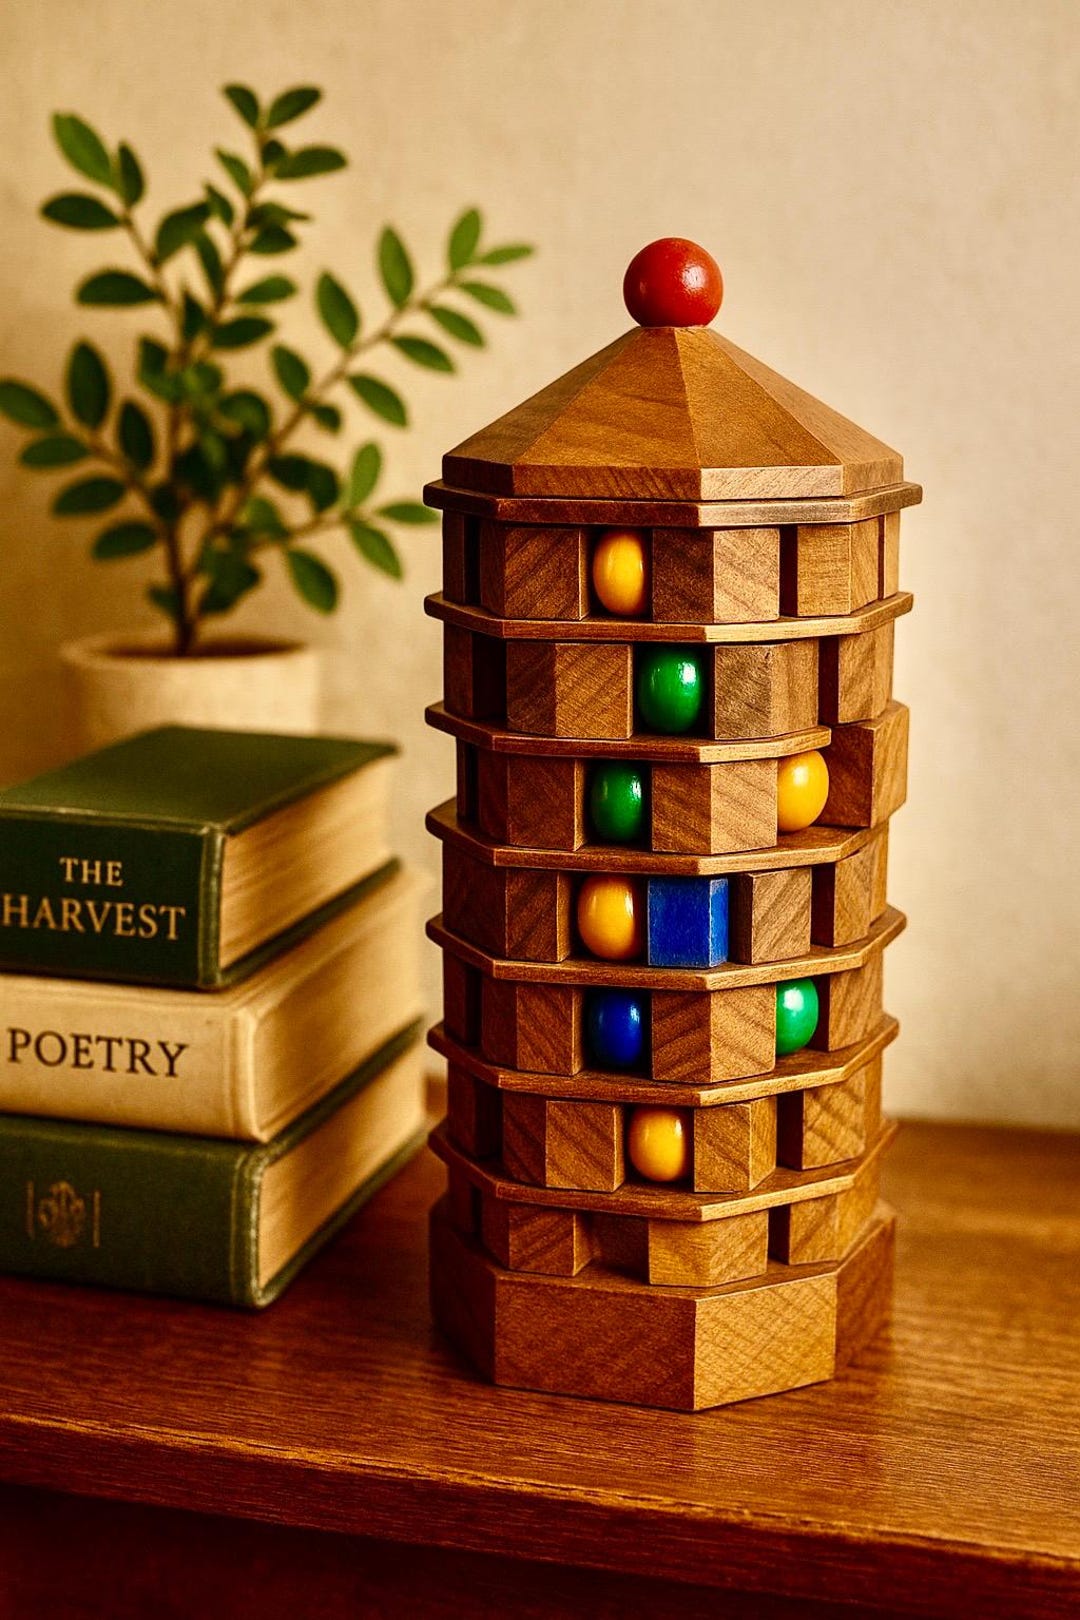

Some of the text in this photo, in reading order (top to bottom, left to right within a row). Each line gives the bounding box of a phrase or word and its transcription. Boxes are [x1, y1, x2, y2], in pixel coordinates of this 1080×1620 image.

[59, 857, 124, 887] THE
[1, 893, 187, 941] HARVEST
[7, 1027, 189, 1078] POETRY
